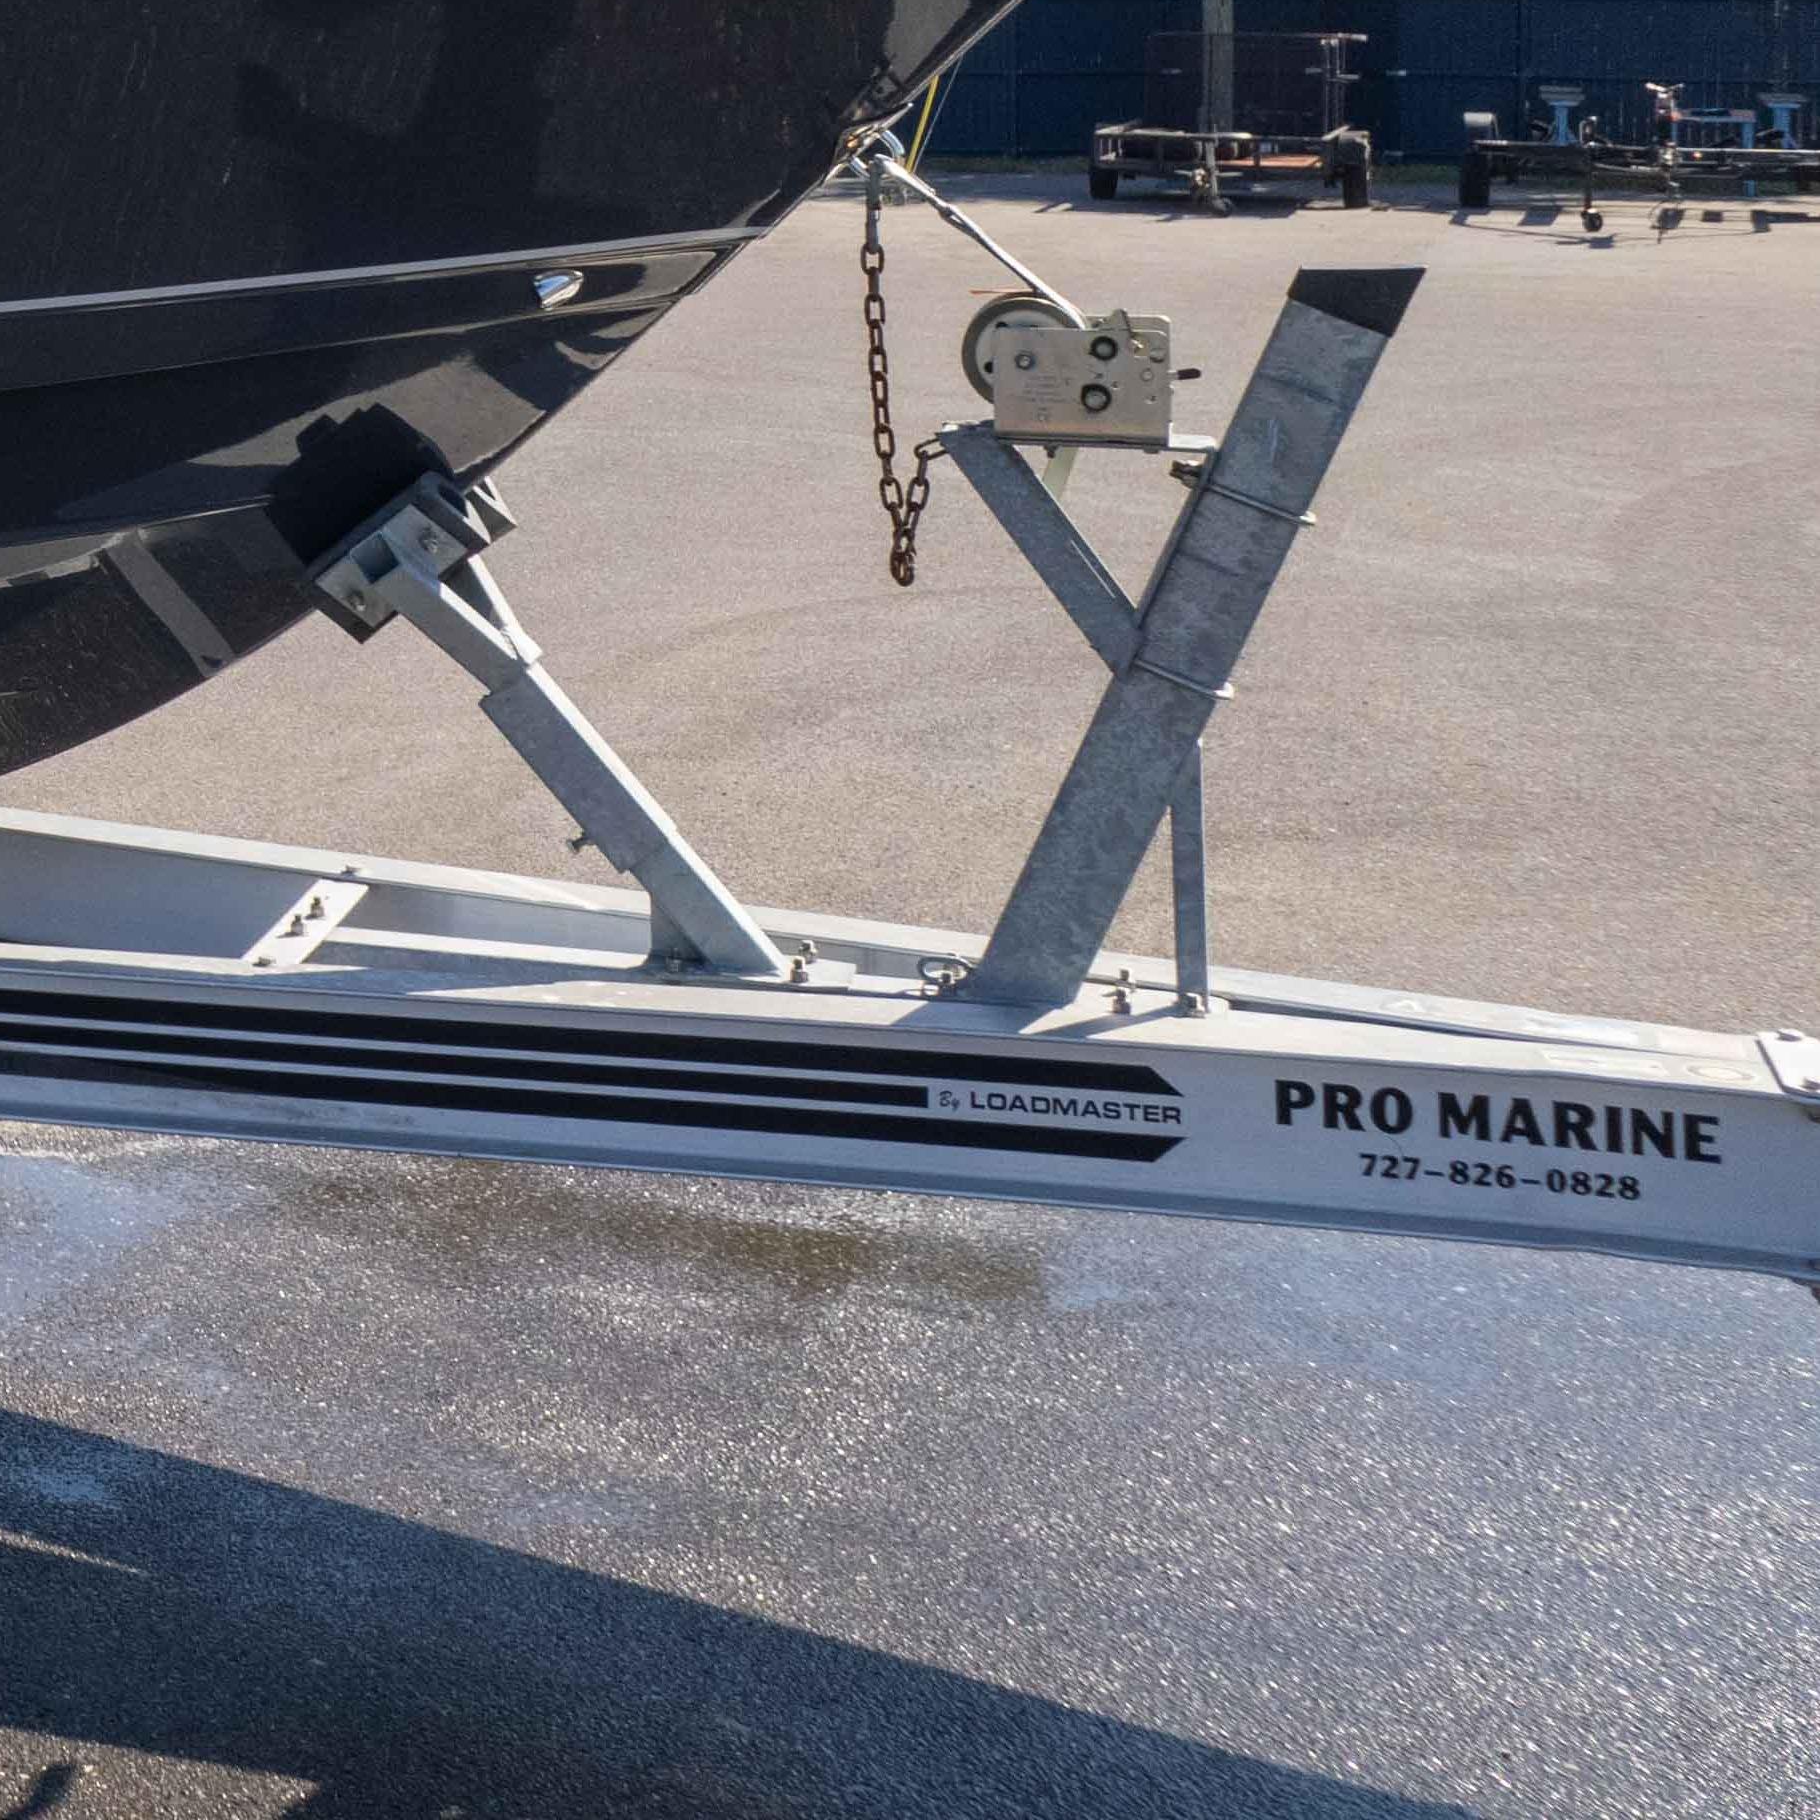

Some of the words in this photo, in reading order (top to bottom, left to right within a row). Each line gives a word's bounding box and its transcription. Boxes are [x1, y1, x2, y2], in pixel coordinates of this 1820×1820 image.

[939, 1090, 961, 1113] By
[970, 1091, 1183, 1125] LOADMASTER
[1274, 1079, 1414, 1135] PRO
[1436, 1091, 1723, 1165] MARINE
[1360, 1153, 1643, 1202] 727-826-0828
